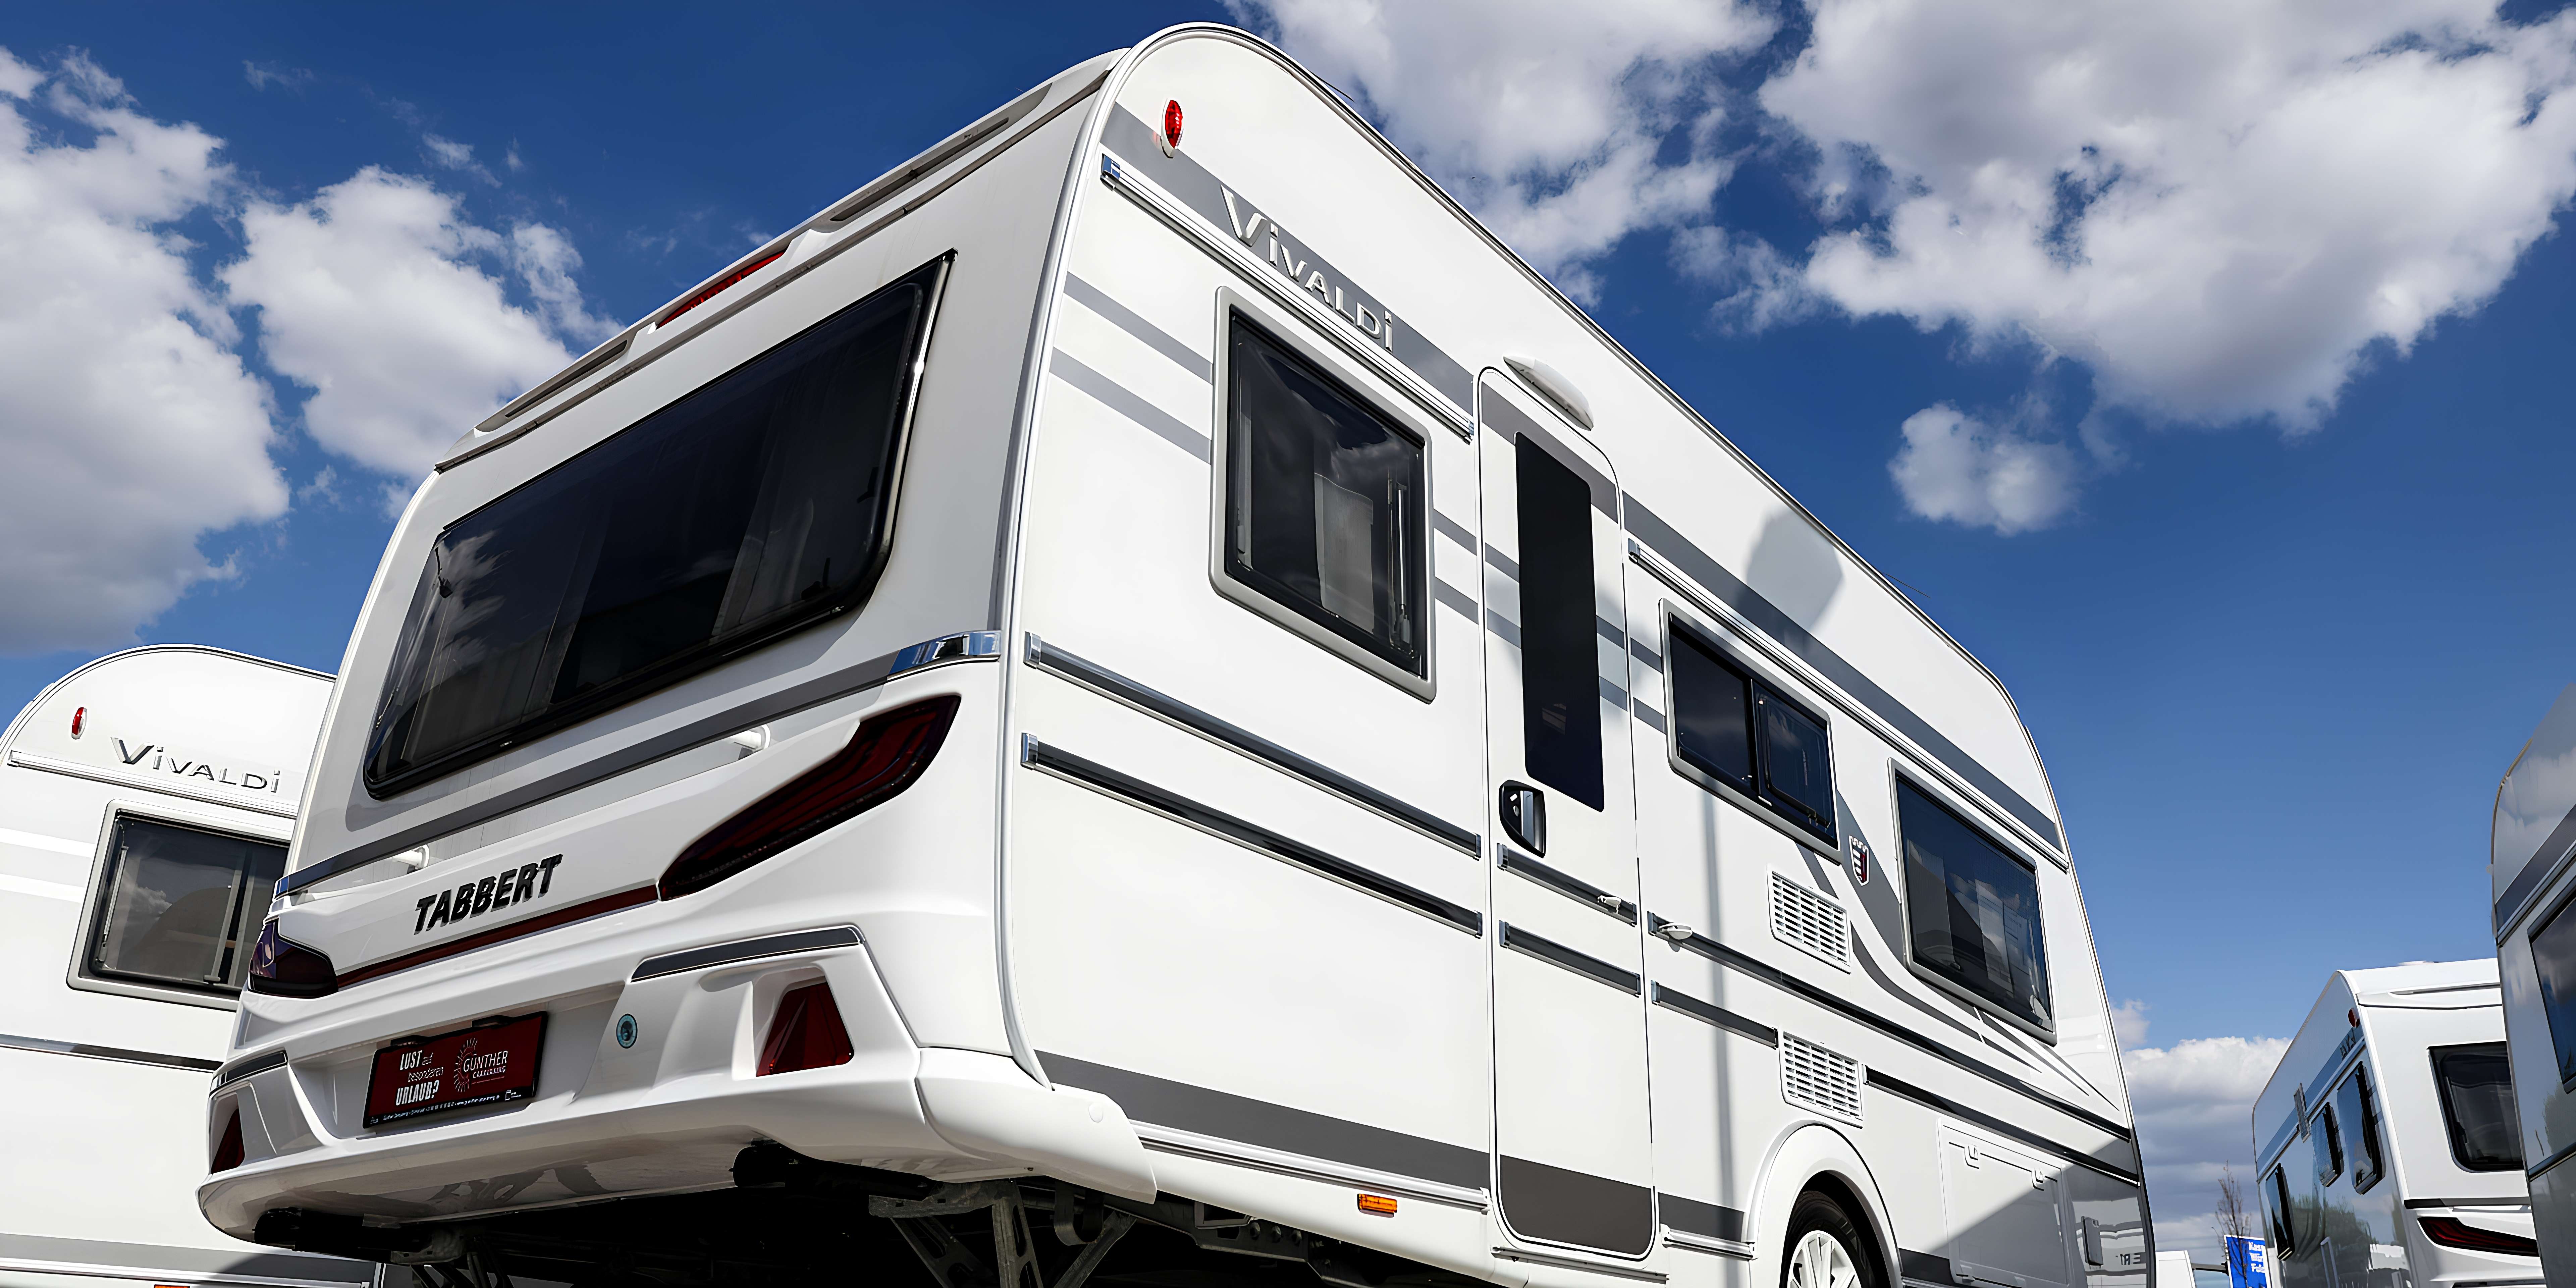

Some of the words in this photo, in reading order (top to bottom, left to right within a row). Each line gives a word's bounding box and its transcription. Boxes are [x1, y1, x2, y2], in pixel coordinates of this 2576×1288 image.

[414, 853, 563, 935] TABBERT
[399, 1050, 423, 1071] LUST
[463, 1051, 508, 1072] GÜNTHER
[395, 1079, 439, 1106] URLAUB?
